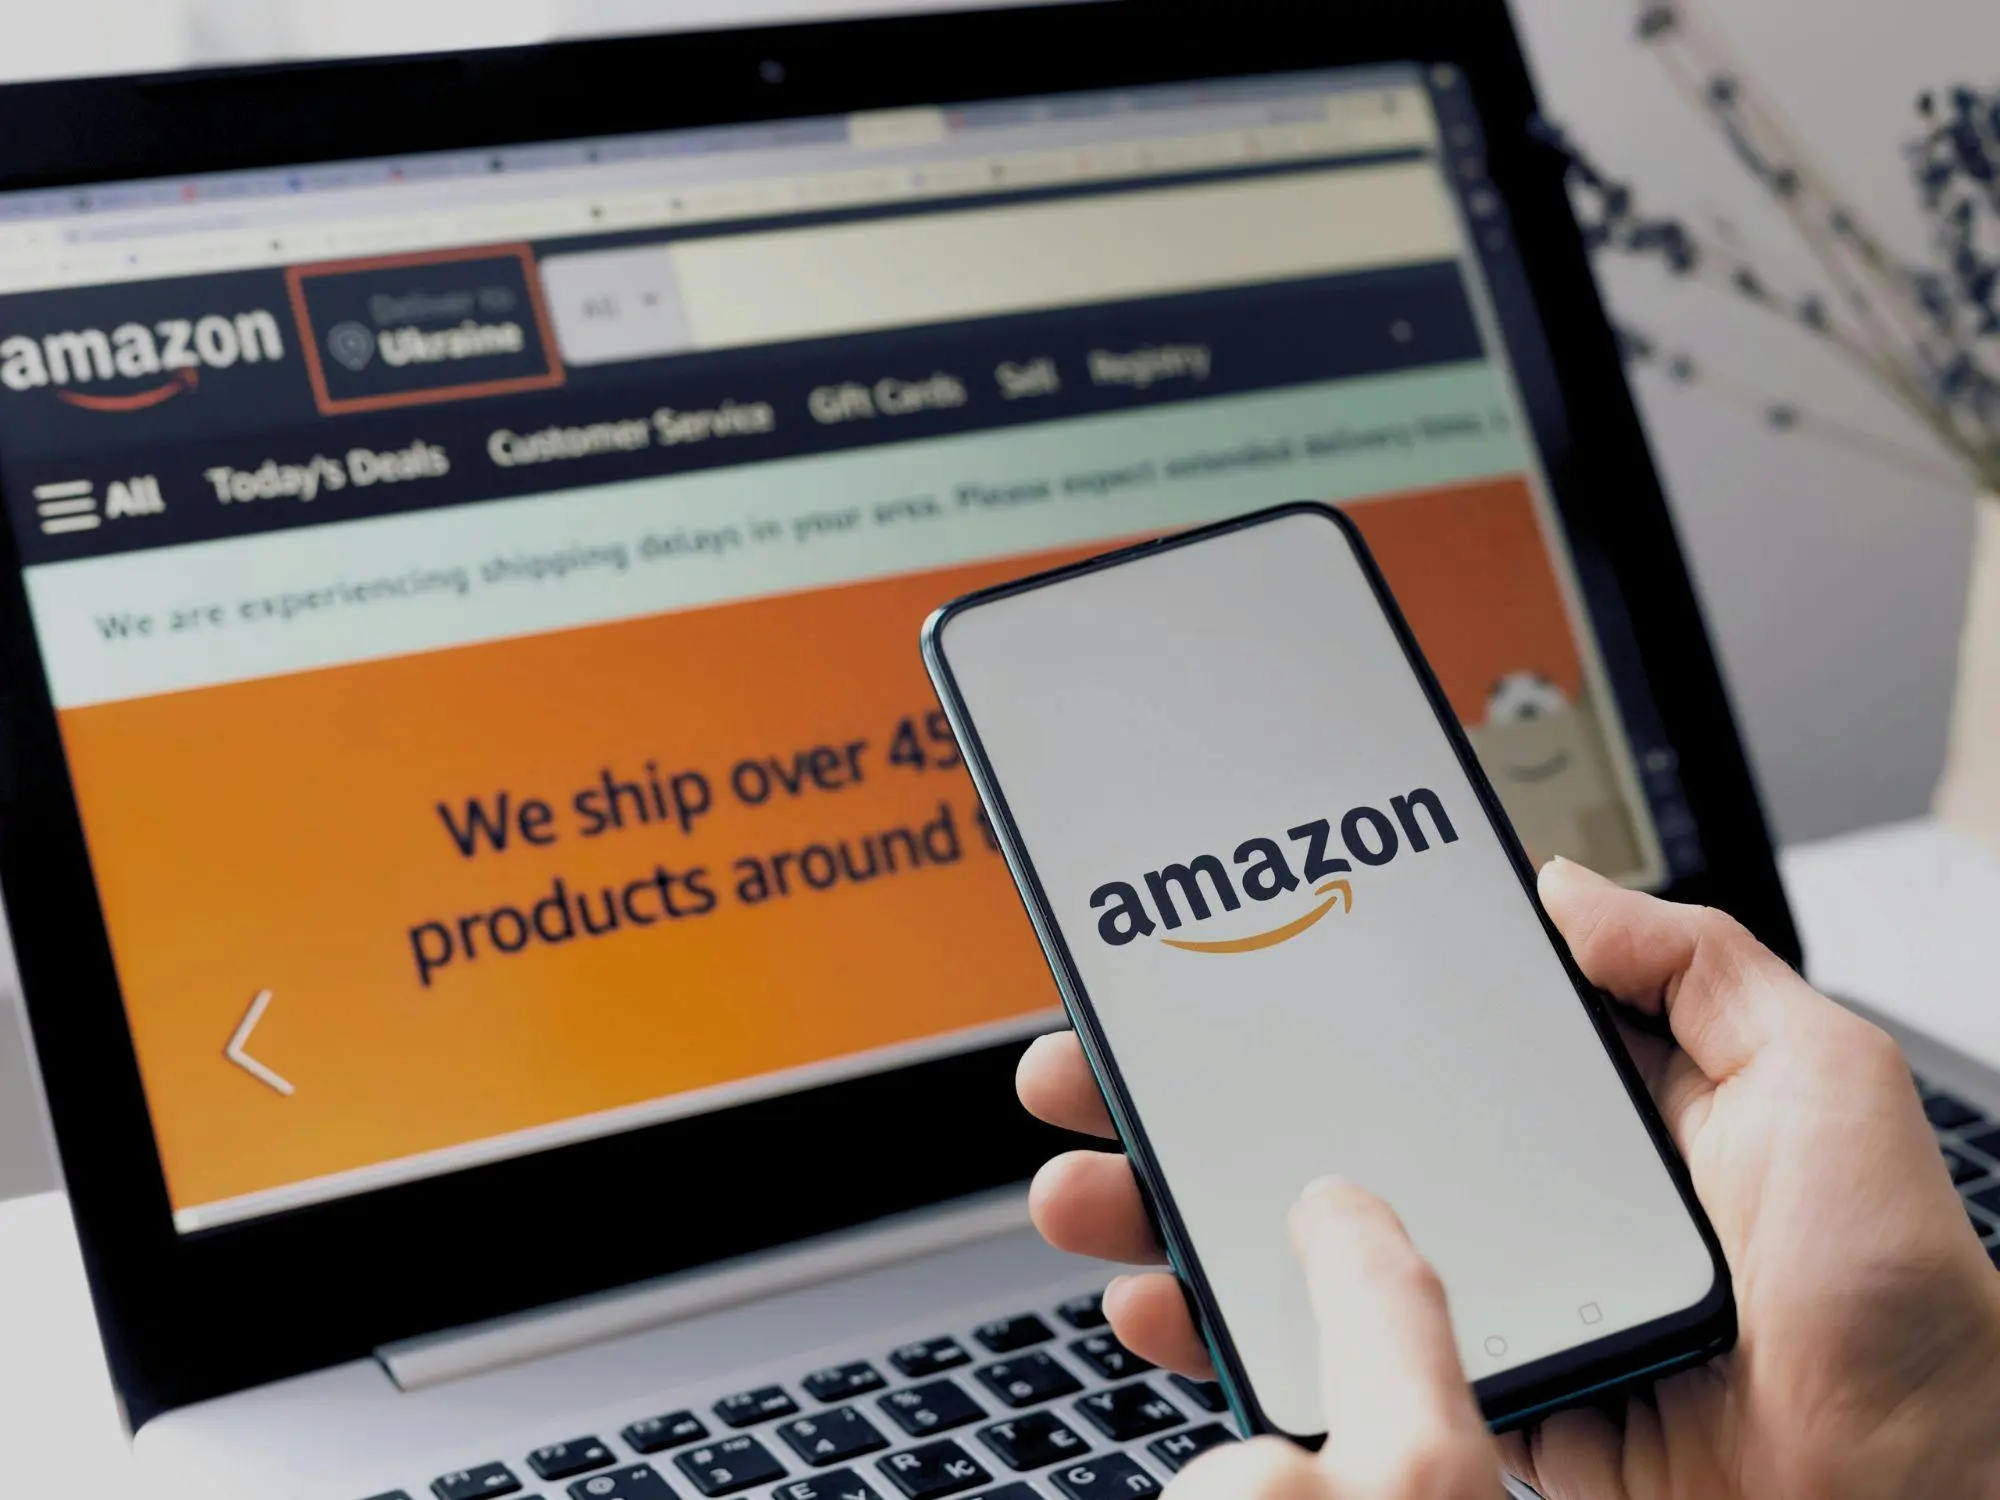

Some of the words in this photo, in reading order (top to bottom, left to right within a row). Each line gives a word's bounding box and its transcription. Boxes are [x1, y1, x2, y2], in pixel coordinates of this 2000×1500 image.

[0, 309, 284, 391] amazon
[378, 319, 524, 367] Ukraine
[1087, 345, 1210, 388] Registry
[809, 382, 874, 424] Gift
[873, 369, 968, 415] Cards
[995, 357, 1060, 399] Sell
[487, 418, 651, 467] Customer
[653, 400, 774, 445] Service
[106, 475, 166, 519] All
[205, 455, 346, 504] Today's
[346, 438, 450, 487] Deals
[97, 613, 152, 639] We
[171, 608, 224, 630] are
[239, 567, 469, 621] experiencing
[482, 541, 630, 580] shipping
[641, 526, 741, 557] delays
[750, 519, 782, 541] in
[793, 506, 860, 541] your
[437, 790, 558, 859] We
[573, 761, 712, 836] ship
[731, 737, 867, 806] over
[889, 710, 962, 771] 45
[408, 862, 717, 987] products
[734, 801, 962, 905] around
[1089, 788, 1459, 946] amazon
[891, 1453, 921, 1471] R
[1067, 1466, 1096, 1484] G
[789, 1482, 818, 1500] E
